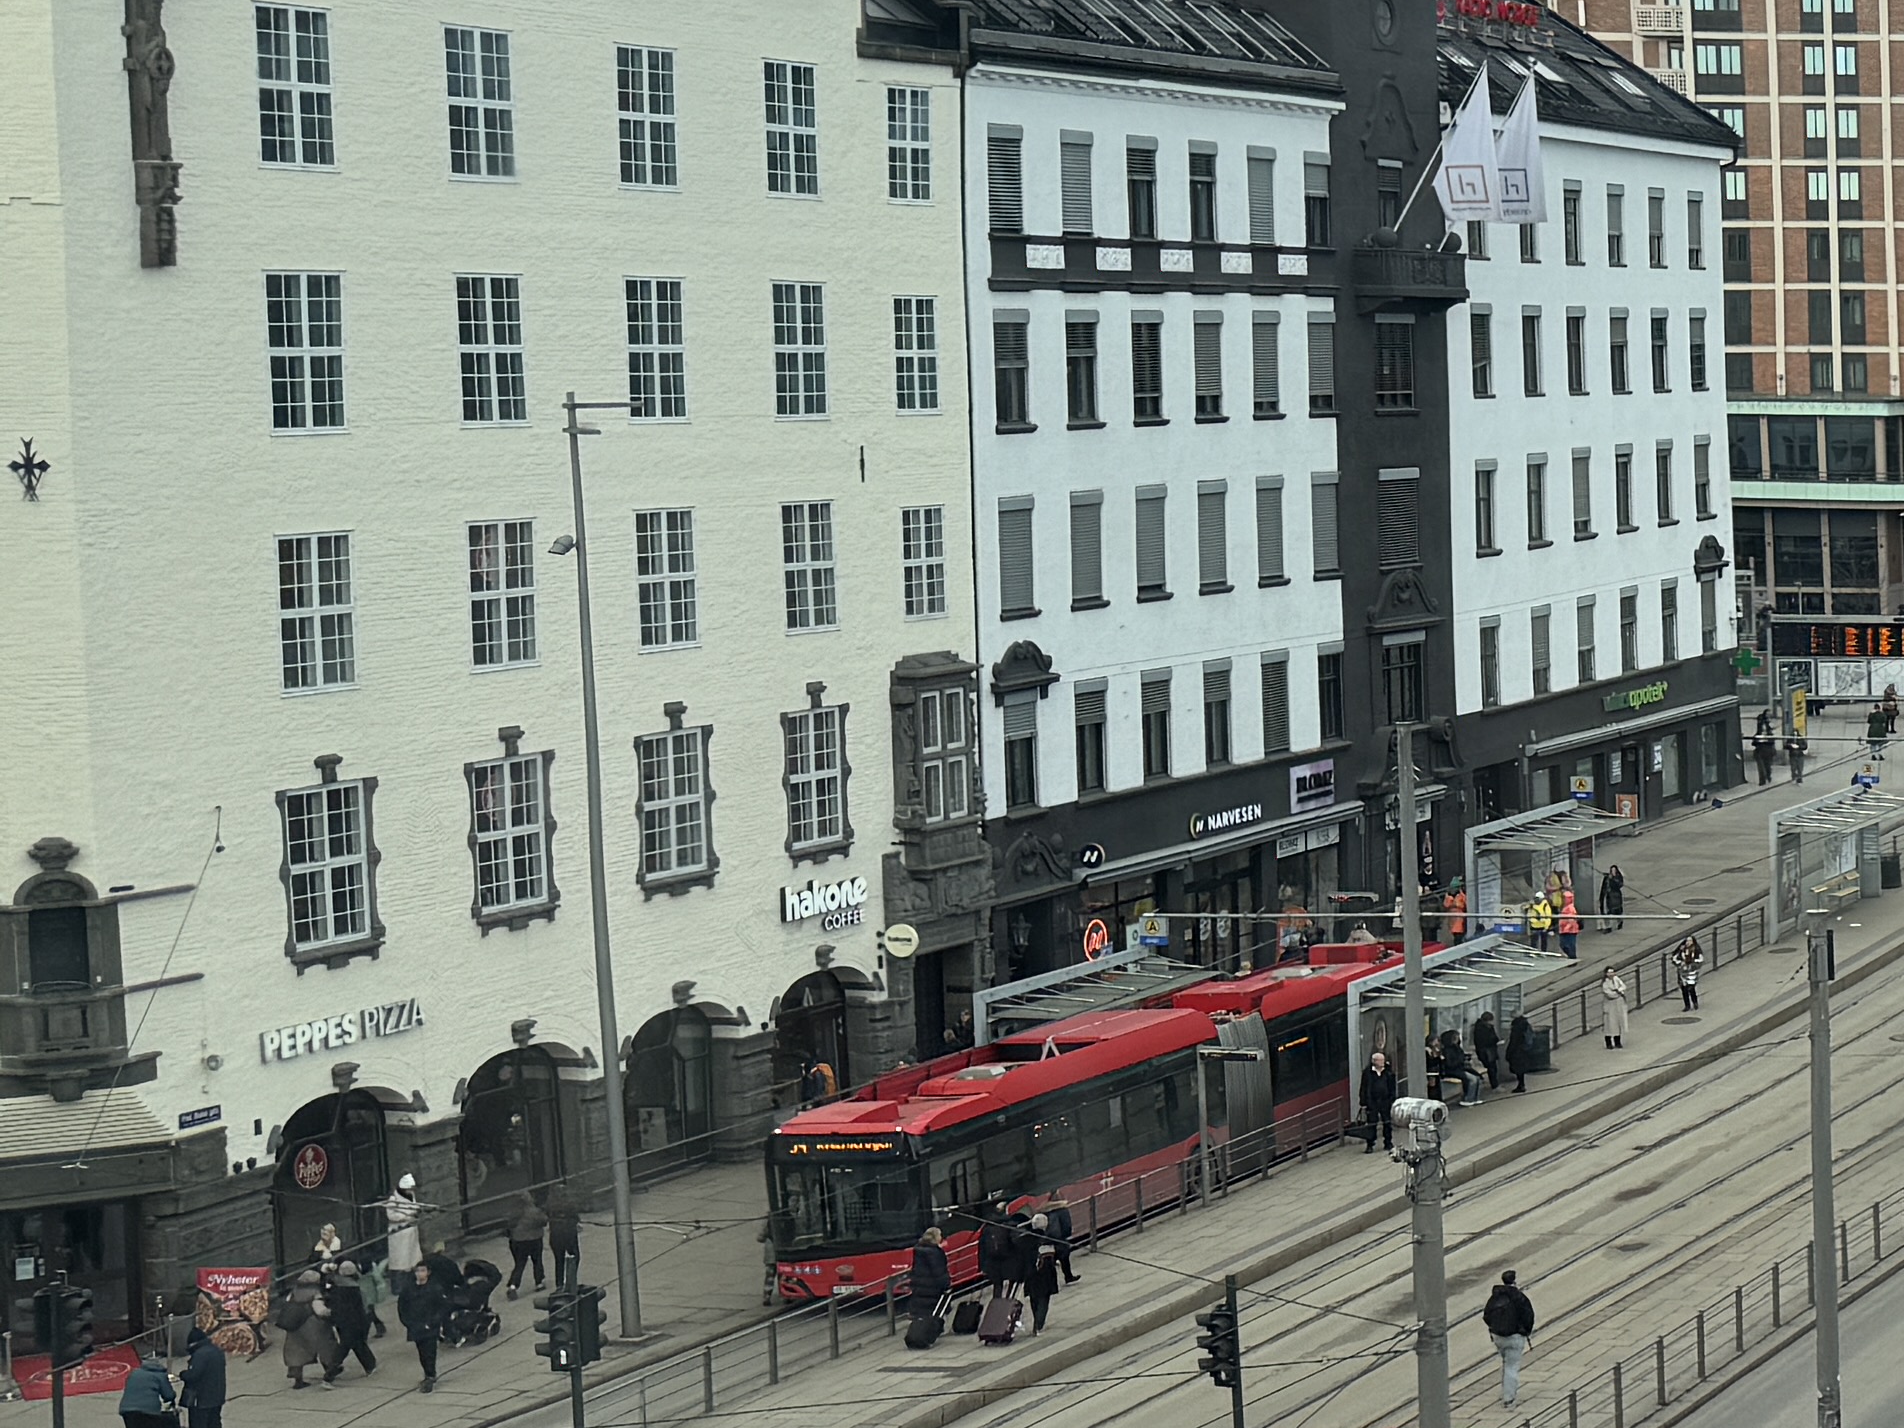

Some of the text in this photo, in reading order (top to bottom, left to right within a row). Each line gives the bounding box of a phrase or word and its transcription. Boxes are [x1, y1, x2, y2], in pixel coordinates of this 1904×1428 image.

[1207, 804, 1261, 831] NARVESEN
[780, 875, 868, 922] hakone
[823, 908, 868, 931] COFFEE
[259, 997, 425, 1064] PEPPES PIZZA
[207, 1274, 260, 1288] Nyheter
